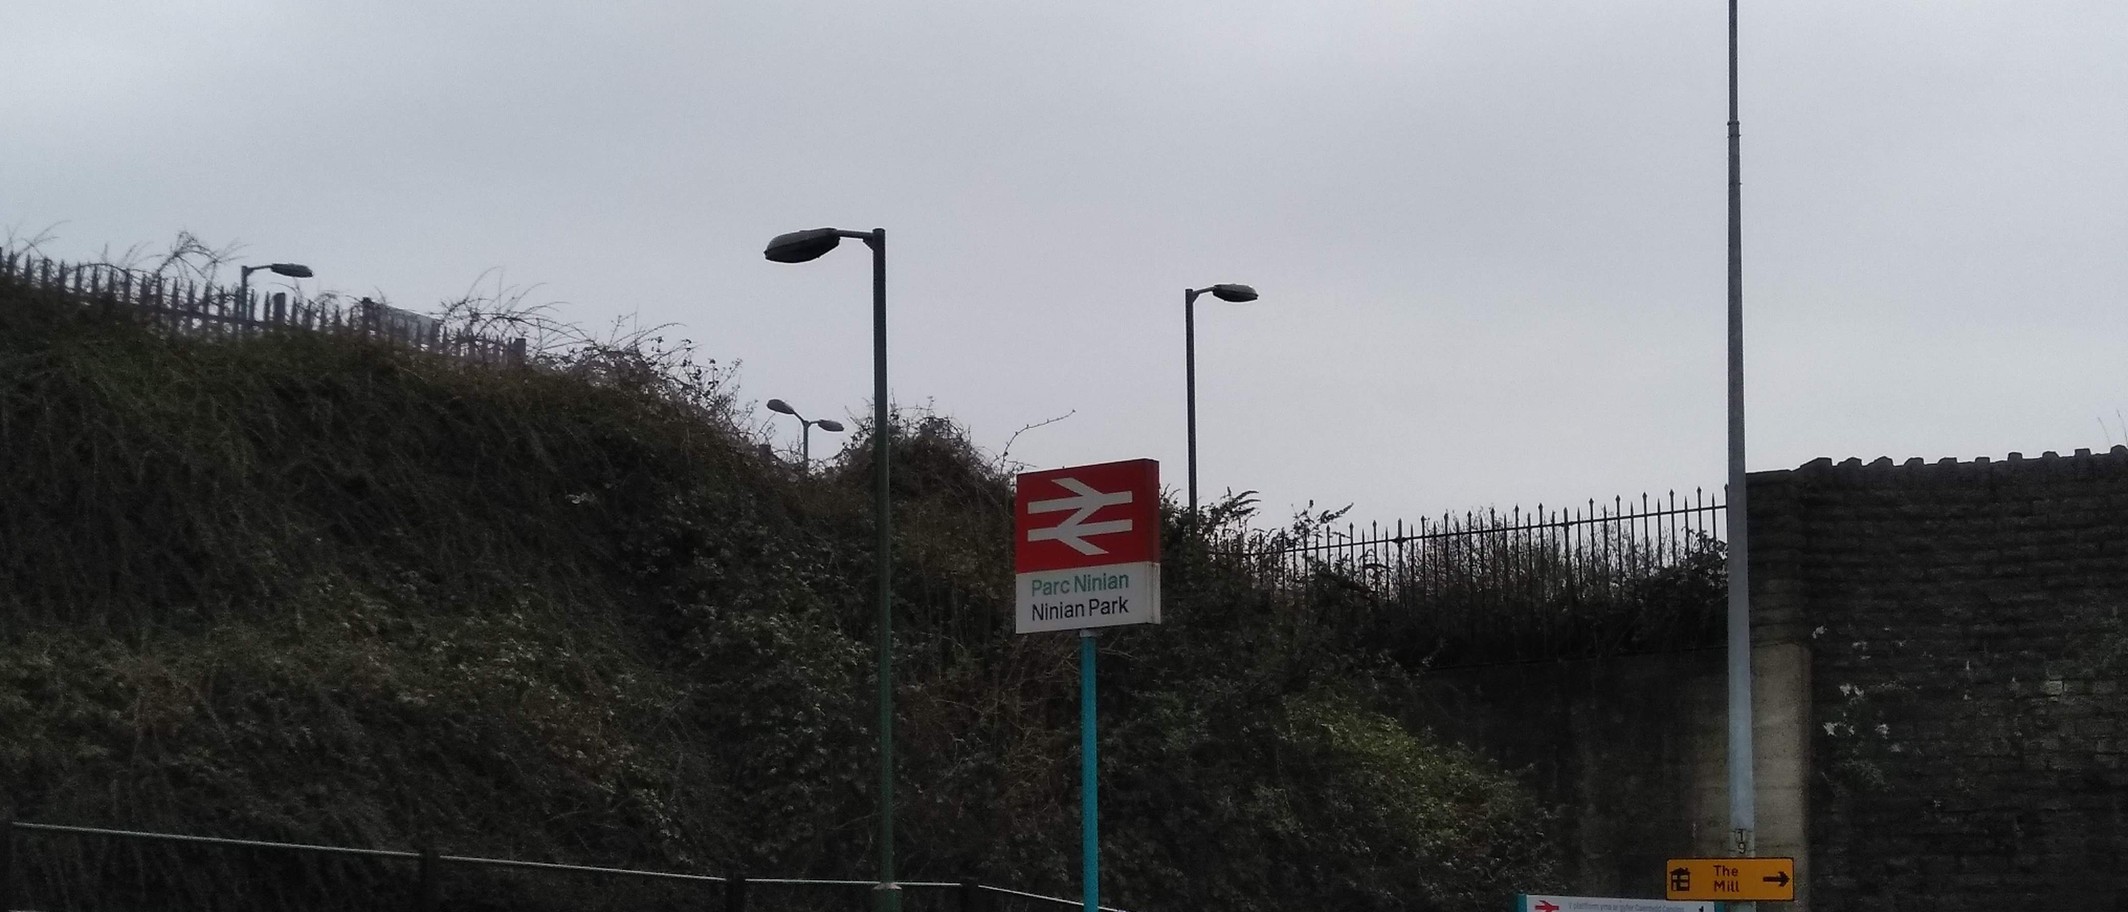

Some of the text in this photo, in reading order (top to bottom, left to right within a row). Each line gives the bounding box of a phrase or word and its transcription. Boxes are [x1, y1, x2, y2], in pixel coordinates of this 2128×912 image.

[1031, 573, 1129, 597] Parc Ninian
[1032, 596, 1129, 621] Ninian Park
[1713, 864, 1739, 877] The
[1713, 880, 1740, 892] Mill
